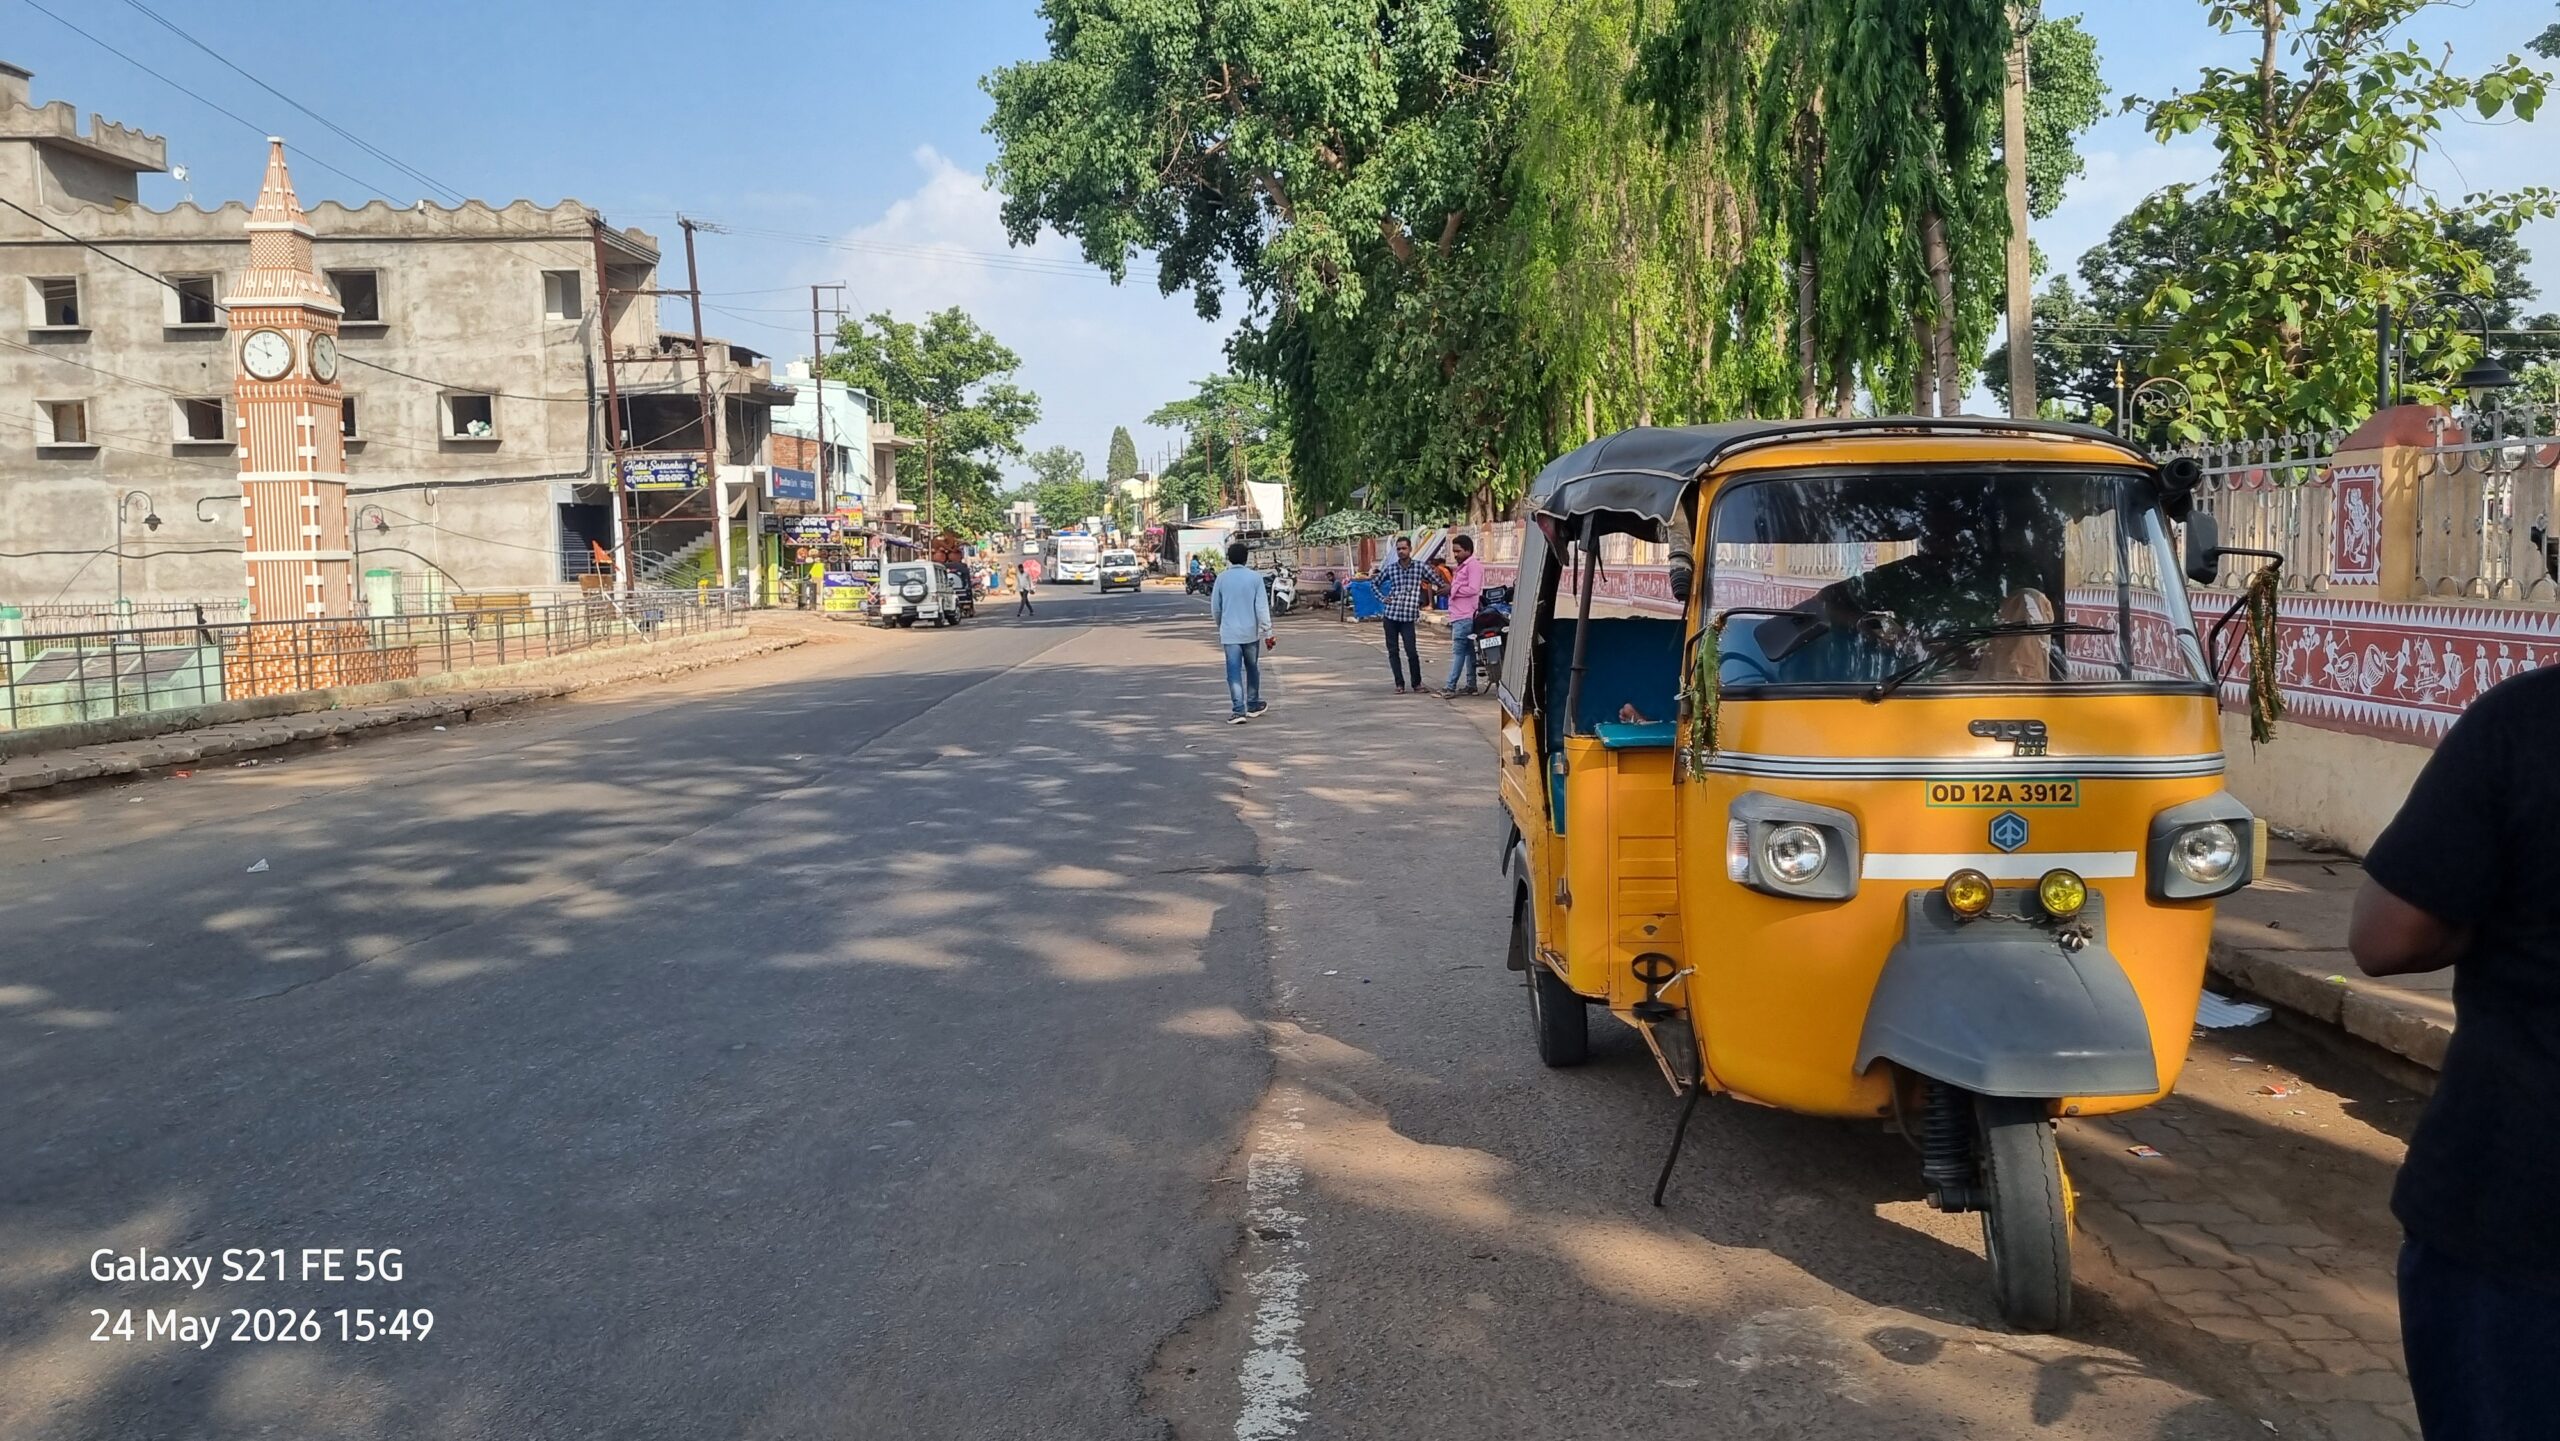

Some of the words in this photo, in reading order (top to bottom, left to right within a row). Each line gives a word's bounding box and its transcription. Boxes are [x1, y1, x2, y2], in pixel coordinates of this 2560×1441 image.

[1970, 721, 2045, 739] ape
[1931, 784, 1965, 802] OD
[1971, 784, 2013, 802] 12A
[2019, 784, 2073, 802] 3912
